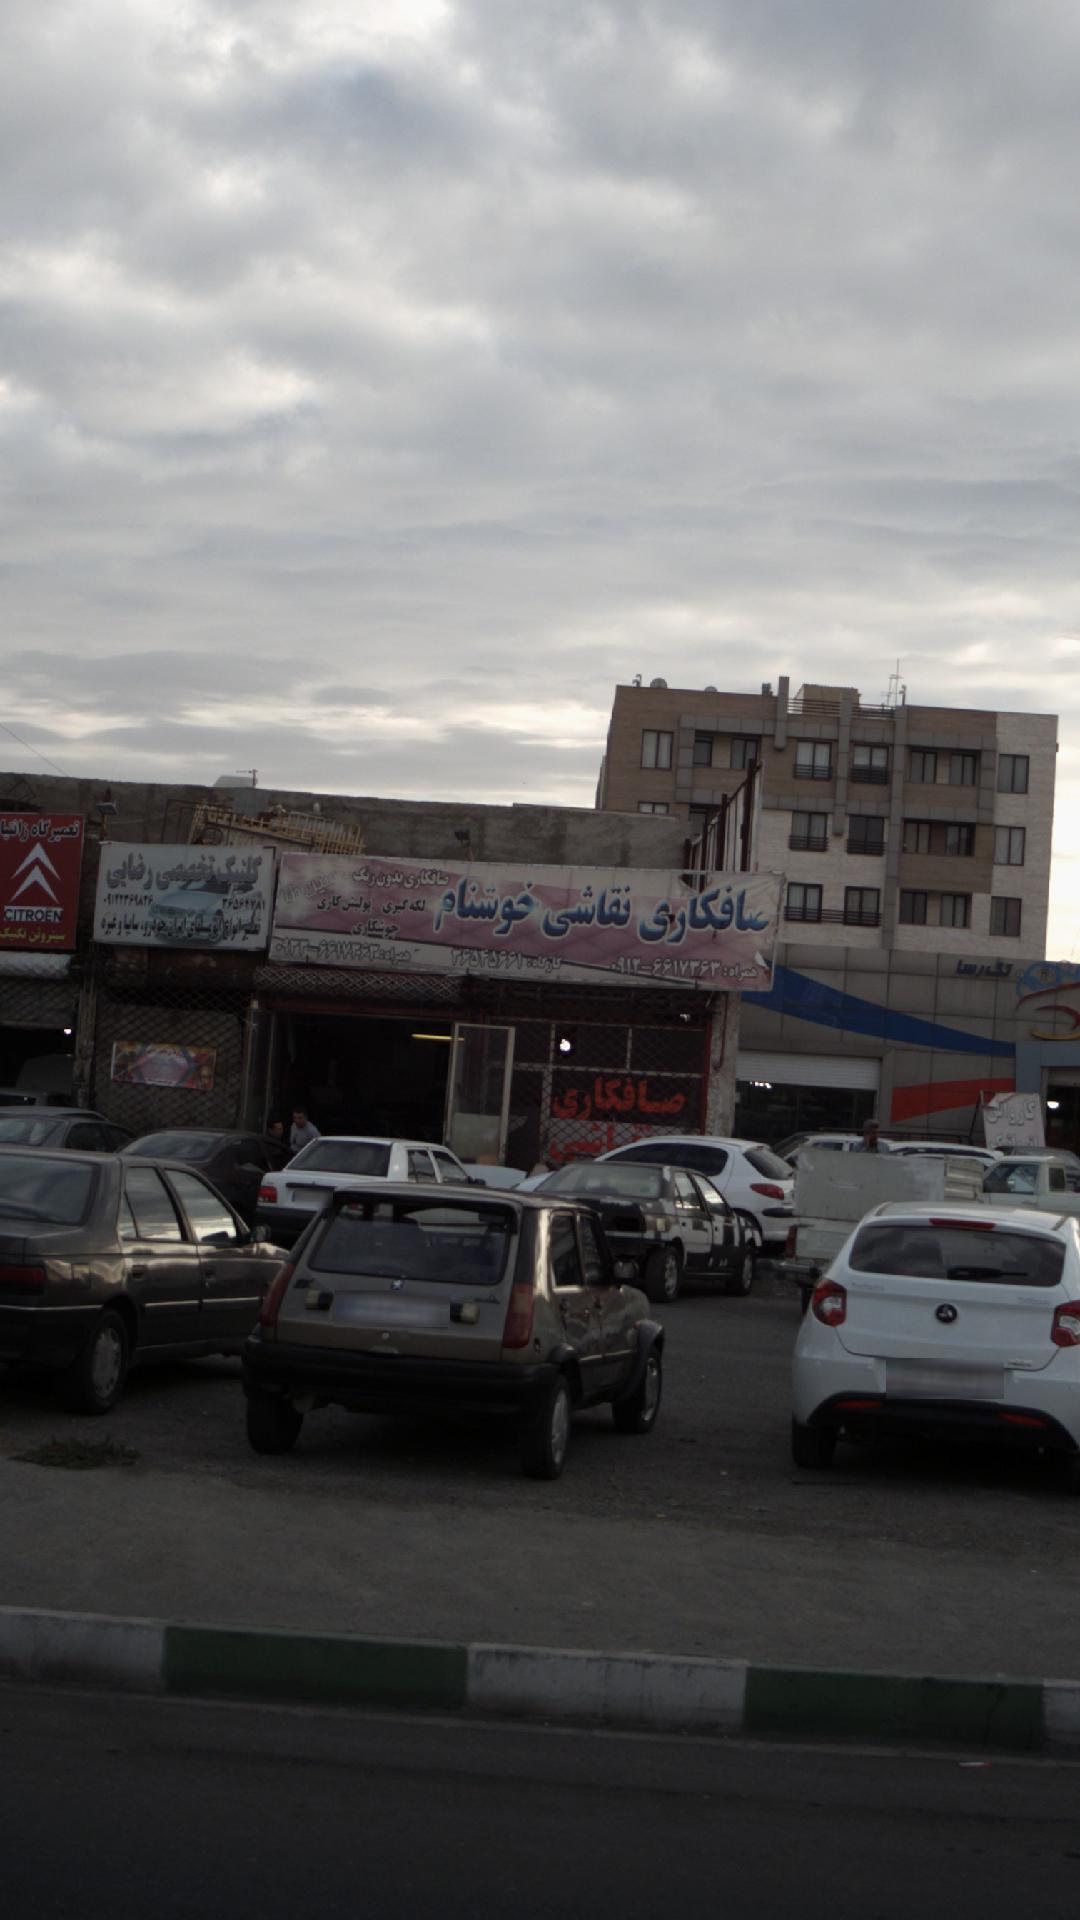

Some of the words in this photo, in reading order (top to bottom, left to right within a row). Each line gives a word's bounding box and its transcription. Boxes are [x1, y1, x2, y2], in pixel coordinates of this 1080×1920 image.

[434, 878, 536, 935] خوشنام
[542, 885, 631, 937] نقاشی
[551, 1075, 687, 1121] صافکاری
